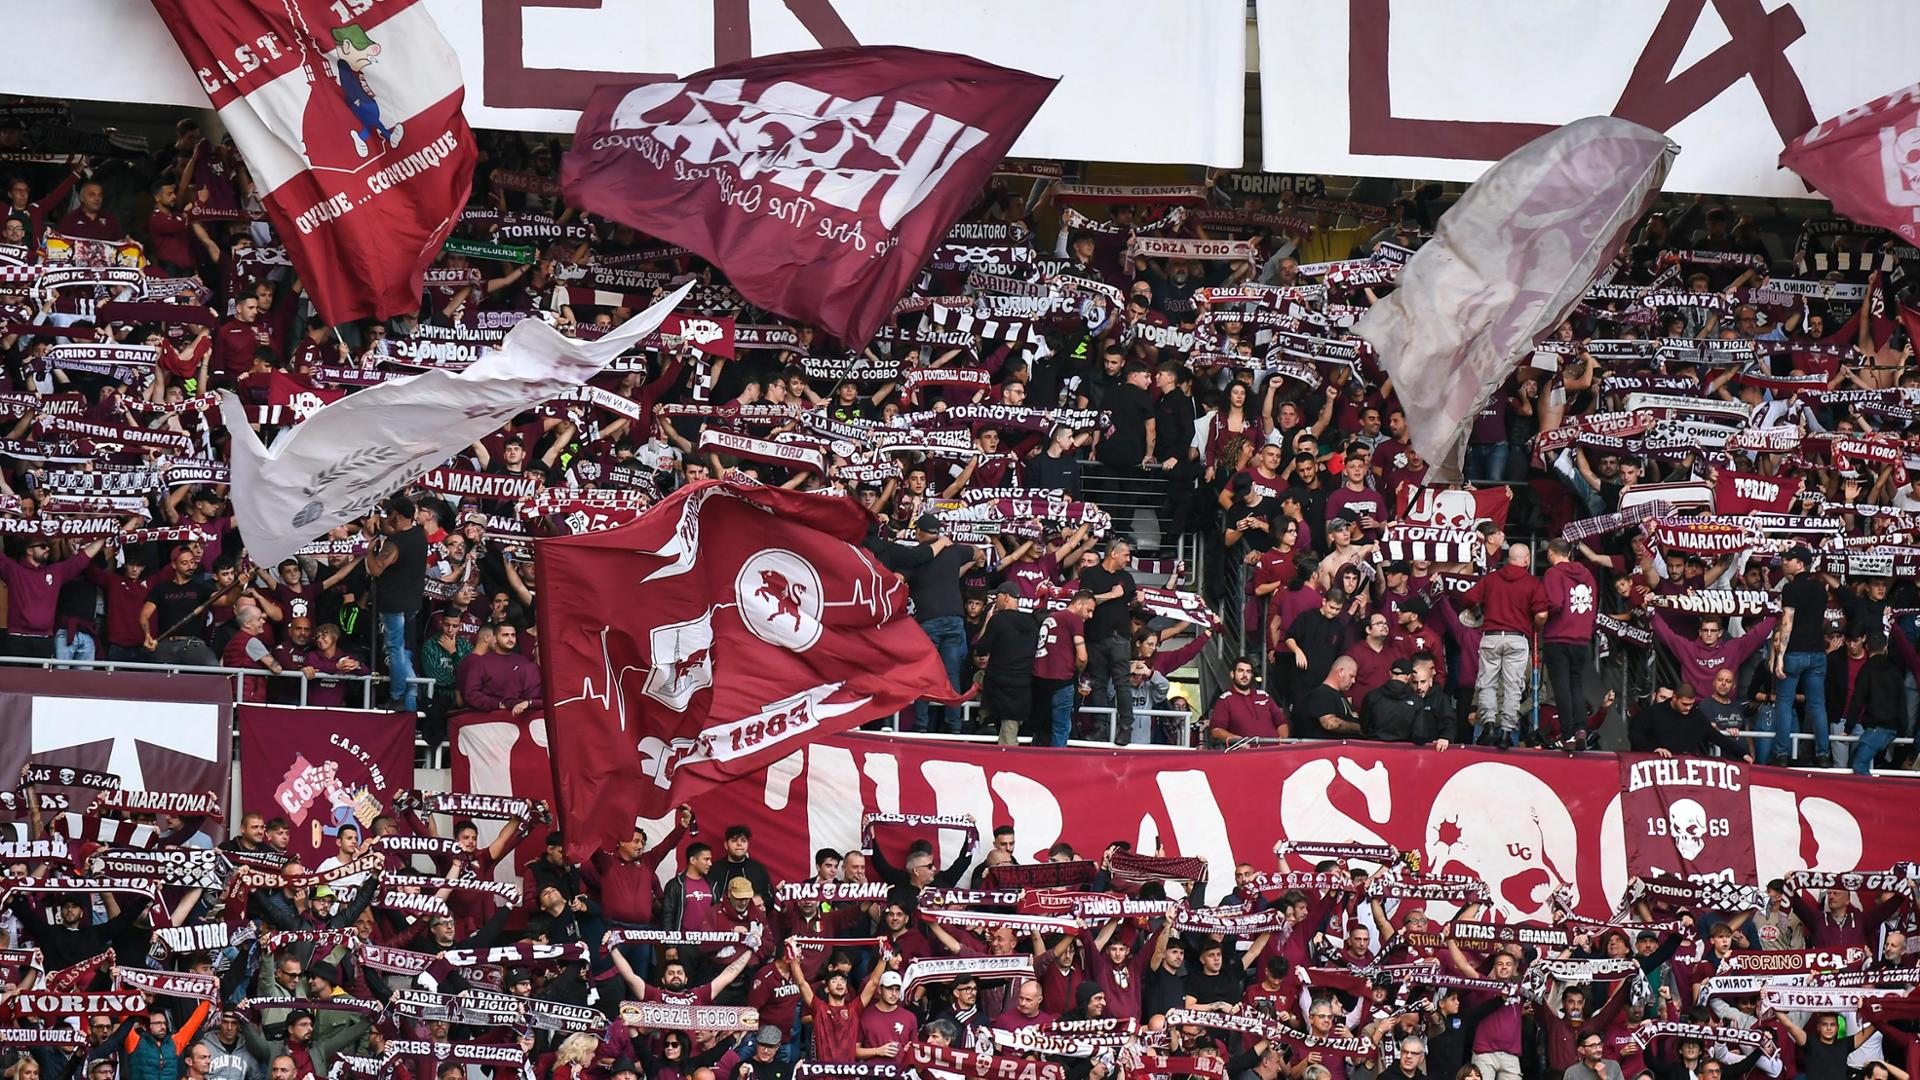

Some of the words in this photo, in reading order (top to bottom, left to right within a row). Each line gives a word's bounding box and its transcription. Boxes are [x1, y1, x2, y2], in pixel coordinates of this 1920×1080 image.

[367, 130, 458, 193] COMUNQUE
[1231, 174, 1292, 193] TORINO
[1296, 175, 1316, 193] FC
[501, 225, 561, 238] TORINO
[566, 226, 587, 239] FC
[1146, 241, 1187, 254] FORZA
[1194, 242, 1230, 254] TORO
[595, 274, 661, 290] GRANATA
[1644, 295, 1720, 309] GRANATA
[765, 330, 797, 343] TORO
[1137, 323, 1194, 350] TORINO
[1663, 339, 1694, 349] PADRE
[1709, 341, 1721, 349] IN
[1325, 345, 1355, 358] TORINO
[874, 360, 900, 369] DIO
[805, 367, 828, 379] NON
[861, 369, 899, 380] GOBBO
[924, 369, 958, 382] FOOTBALL
[960, 370, 977, 382] CLUB
[1820, 392, 1883, 404] GRANATA
[56, 418, 117, 440] SANTENA
[123, 429, 193, 449] GRANATA
[1736, 433, 1767, 448] FORZA
[718, 434, 753, 450] FORZA
[775, 446, 804, 459] TORO
[1871, 445, 1897, 460] TORO
[165, 470, 211, 482] TORINO
[425, 471, 443, 487] LA
[448, 472, 536, 498] MARATONA
[1735, 478, 1779, 502] TORINO
[591, 488, 615, 501] PER
[964, 487, 1024, 502] TORINO
[1396, 526, 1478, 544] TORINO
[1659, 530, 1674, 545] LA
[1678, 532, 1750, 551] MARATONA
[1844, 535, 1877, 546] TORINO
[1827, 563, 1845, 574] FATO
[1668, 595, 1735, 614] TORINO
[1739, 597, 1762, 615] FC
[330, 733, 370, 767] C.A.S.T.
[368, 763, 387, 790] 1983
[1629, 759, 1741, 792] ATHLETIC
[105, 790, 123, 807] LA
[127, 791, 208, 812] MARATONA
[438, 795, 455, 810] LA
[1647, 817, 1667, 836] 19
[1709, 818, 1730, 837] 69
[383, 836, 439, 851] TORINO
[1507, 843, 1532, 861] UG
[107, 861, 155, 875] TORINO
[946, 888, 986, 904] ALE'
[1391, 889, 1465, 901] GRANATA
[1647, 882, 1693, 898] TORINO
[385, 890, 449, 917] GRANATA
[1084, 901, 1120, 916] CUNEO
[197, 922, 228, 949] TORO
[625, 930, 681, 941] ORGOGLIO
[686, 930, 740, 943] GRANATA
[1455, 923, 1495, 940] ULTRAS
[1519, 928, 1568, 946] GRANATA
[918, 959, 966, 972] FORZA
[978, 957, 1021, 969] TORO
[1740, 954, 1803, 971] TORINO
[1806, 953, 1829, 969] FC
[18, 995, 147, 1014] TORINO
[404, 990, 443, 1006] PADRE
[462, 1000, 475, 1010] IN
[477, 1000, 518, 1012] FIGLIO
[1788, 994, 1834, 1007] FORZA
[535, 1002, 550, 1013] IN
[553, 1004, 592, 1018] FIGLIO
[644, 1009, 690, 1025] FORZA
[700, 1011, 737, 1025] TORO
[493, 1015, 515, 1023] 1906
[566, 1021, 587, 1031] 1906
[40, 1029, 71, 1043] CUORE
[1657, 1021, 1714, 1037] FORZA
[1716, 1026, 1762, 1043] TORO
[454, 1044, 524, 1064] GRANATA
[914, 1043, 970, 1071] ULT
[801, 1064, 868, 1077] TORINO
[874, 1064, 897, 1078] FC
